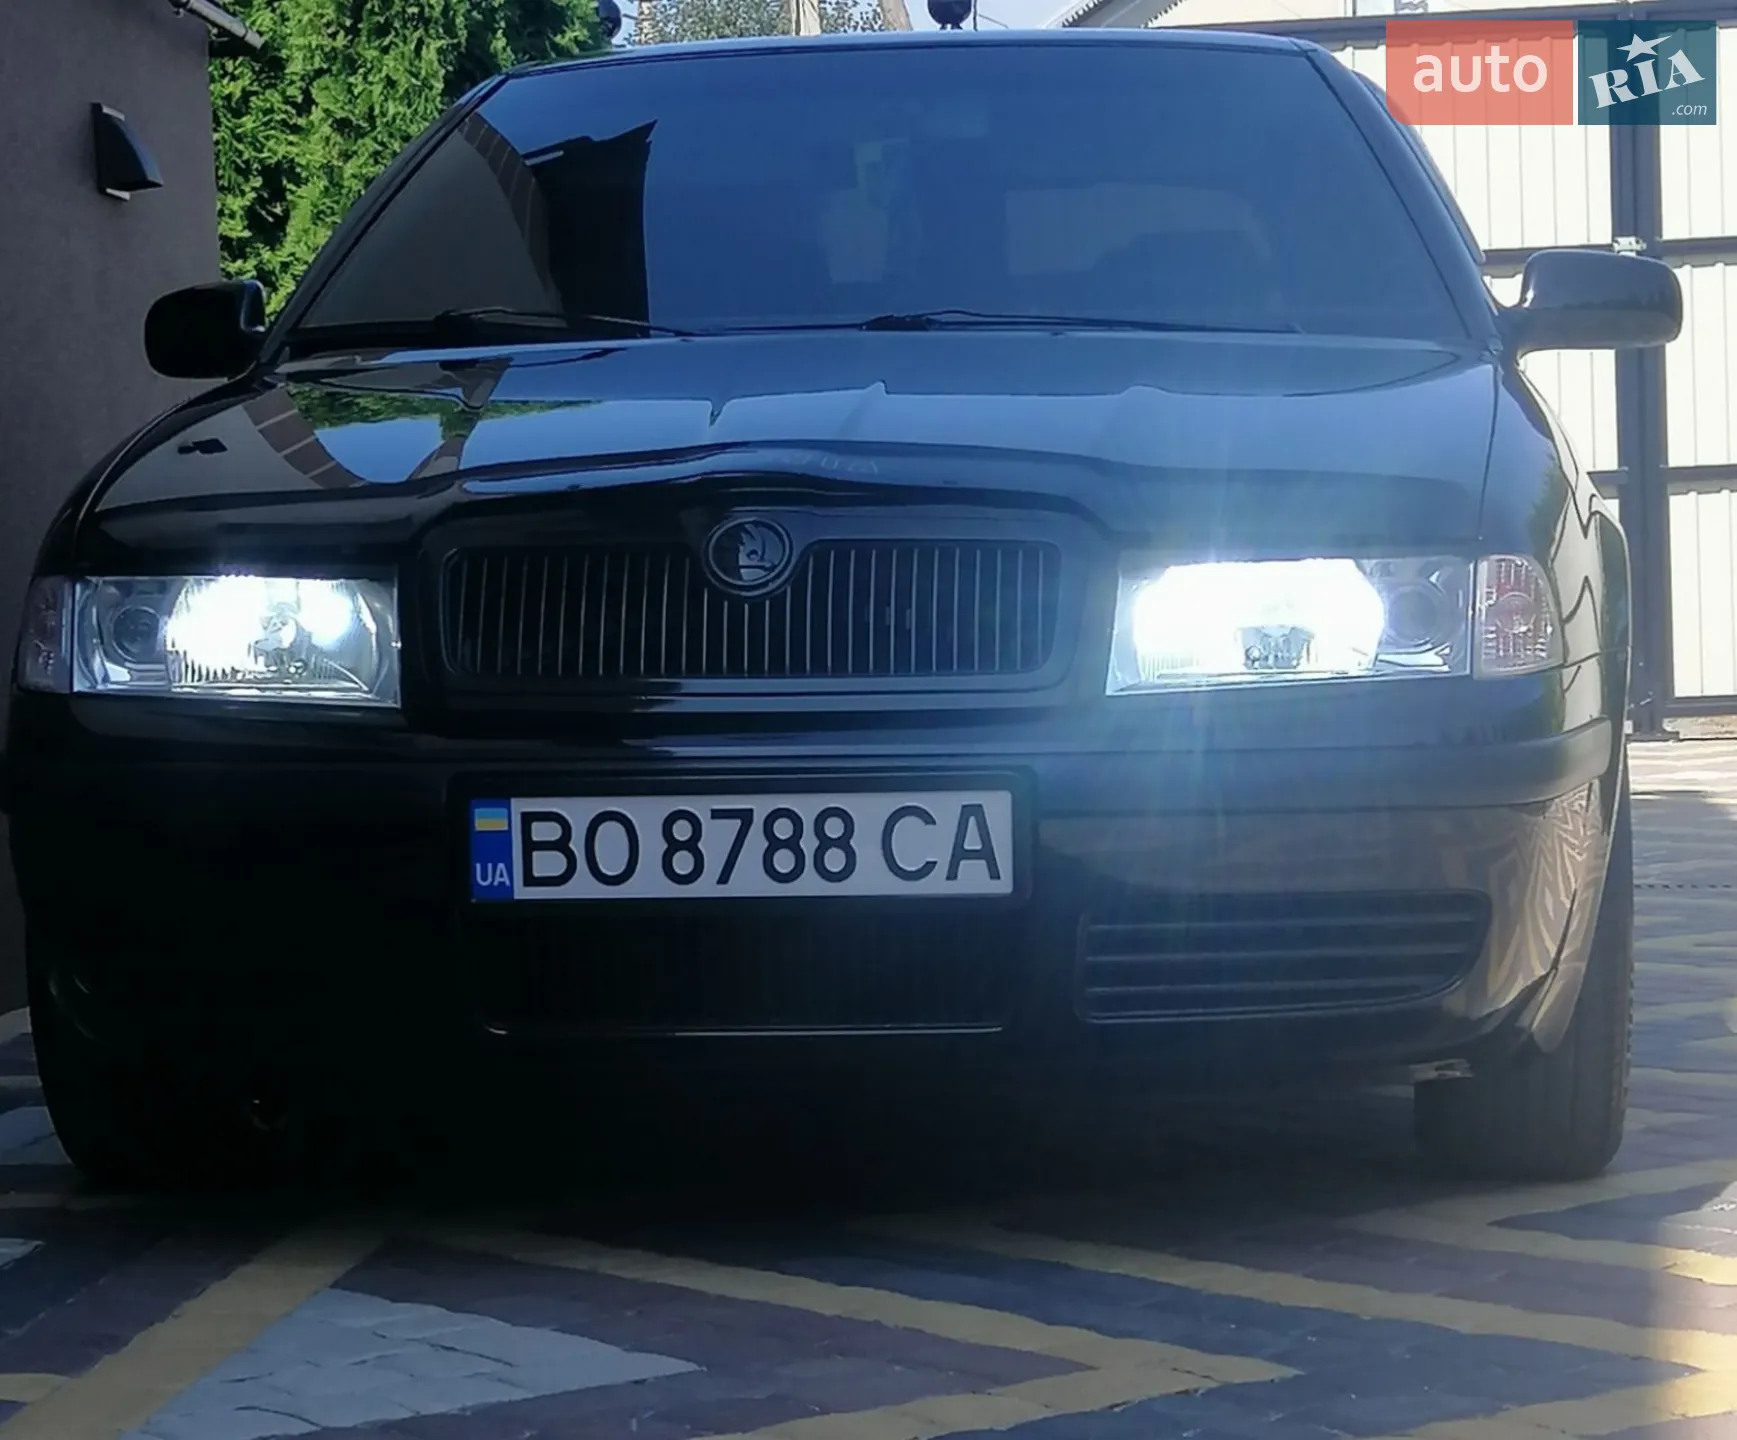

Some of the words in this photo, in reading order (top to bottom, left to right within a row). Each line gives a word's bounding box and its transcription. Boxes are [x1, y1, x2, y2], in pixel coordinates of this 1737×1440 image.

[519, 809, 640, 888] BO
[661, 804, 858, 886] 8788
[881, 802, 1002, 883] CA
[475, 862, 511, 887] UA
